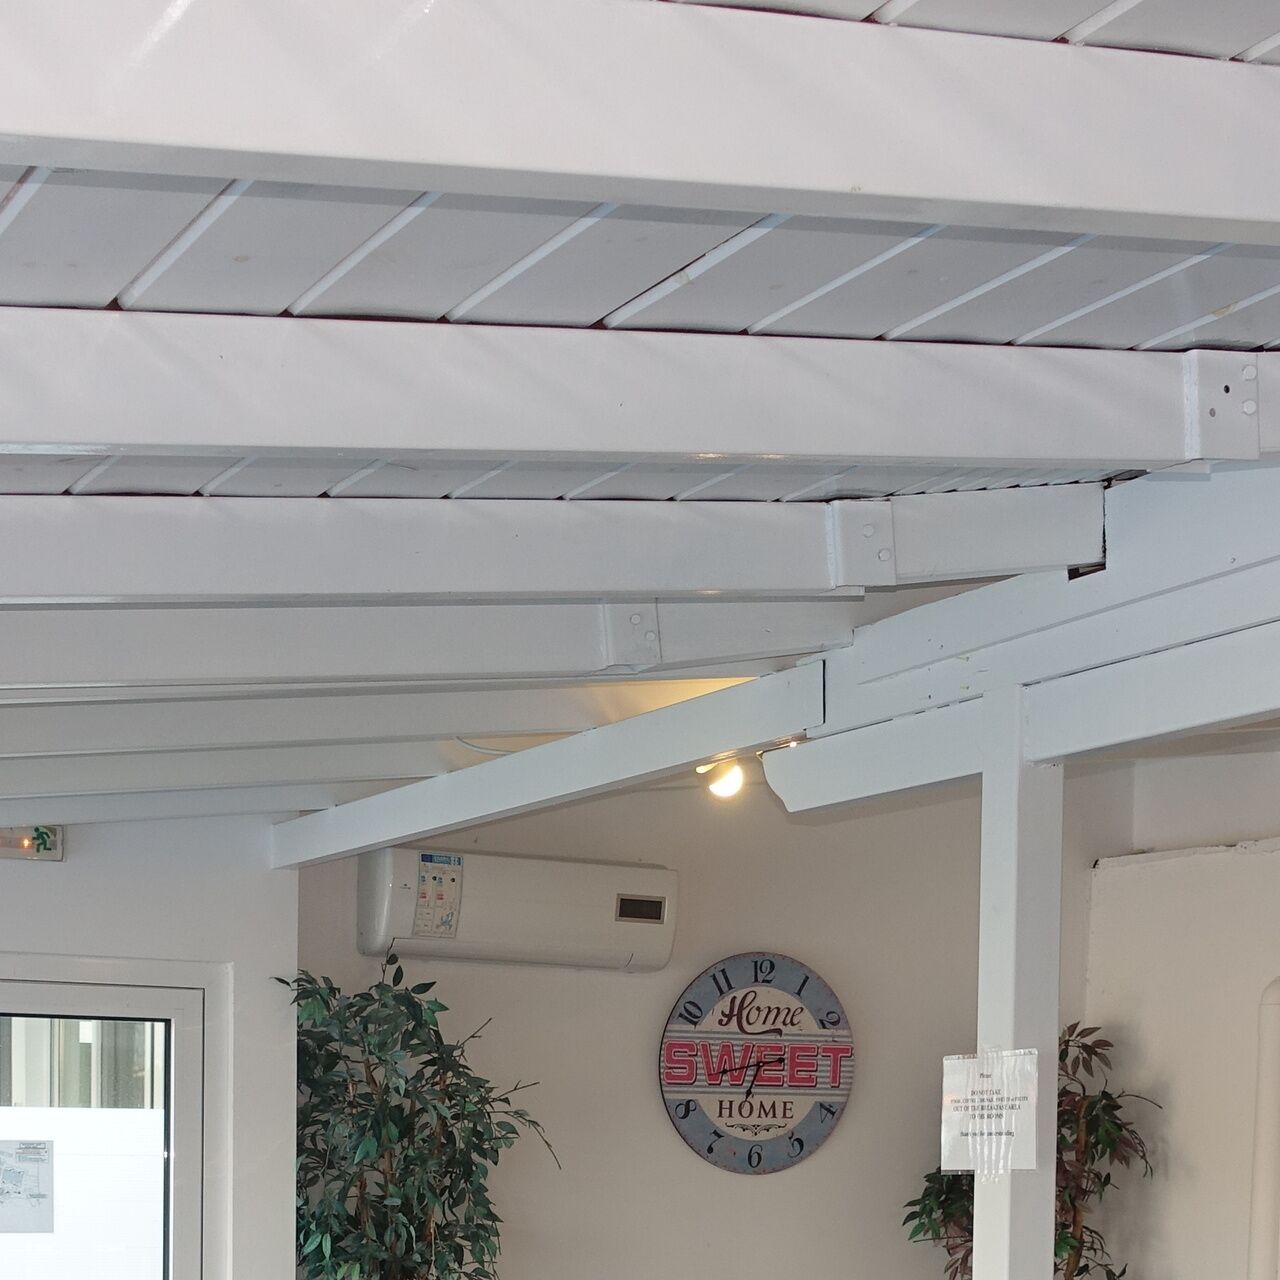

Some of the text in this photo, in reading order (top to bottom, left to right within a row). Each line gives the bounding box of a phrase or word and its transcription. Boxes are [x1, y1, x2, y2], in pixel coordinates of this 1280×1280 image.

[710, 968, 735, 996] 11
[752, 959, 776, 984] 12
[794, 973, 809, 997] 1
[676, 1000, 703, 1028] 10
[718, 990, 804, 1037] Home
[818, 1011, 841, 1030] 2
[663, 1041, 853, 1088] SWEET
[674, 1099, 697, 1120] 8
[717, 1100, 795, 1120] HOME
[819, 1101, 838, 1124] 4
[706, 1130, 724, 1154] 7
[787, 1132, 804, 1158] 5
[747, 1144, 763, 1168] 6
